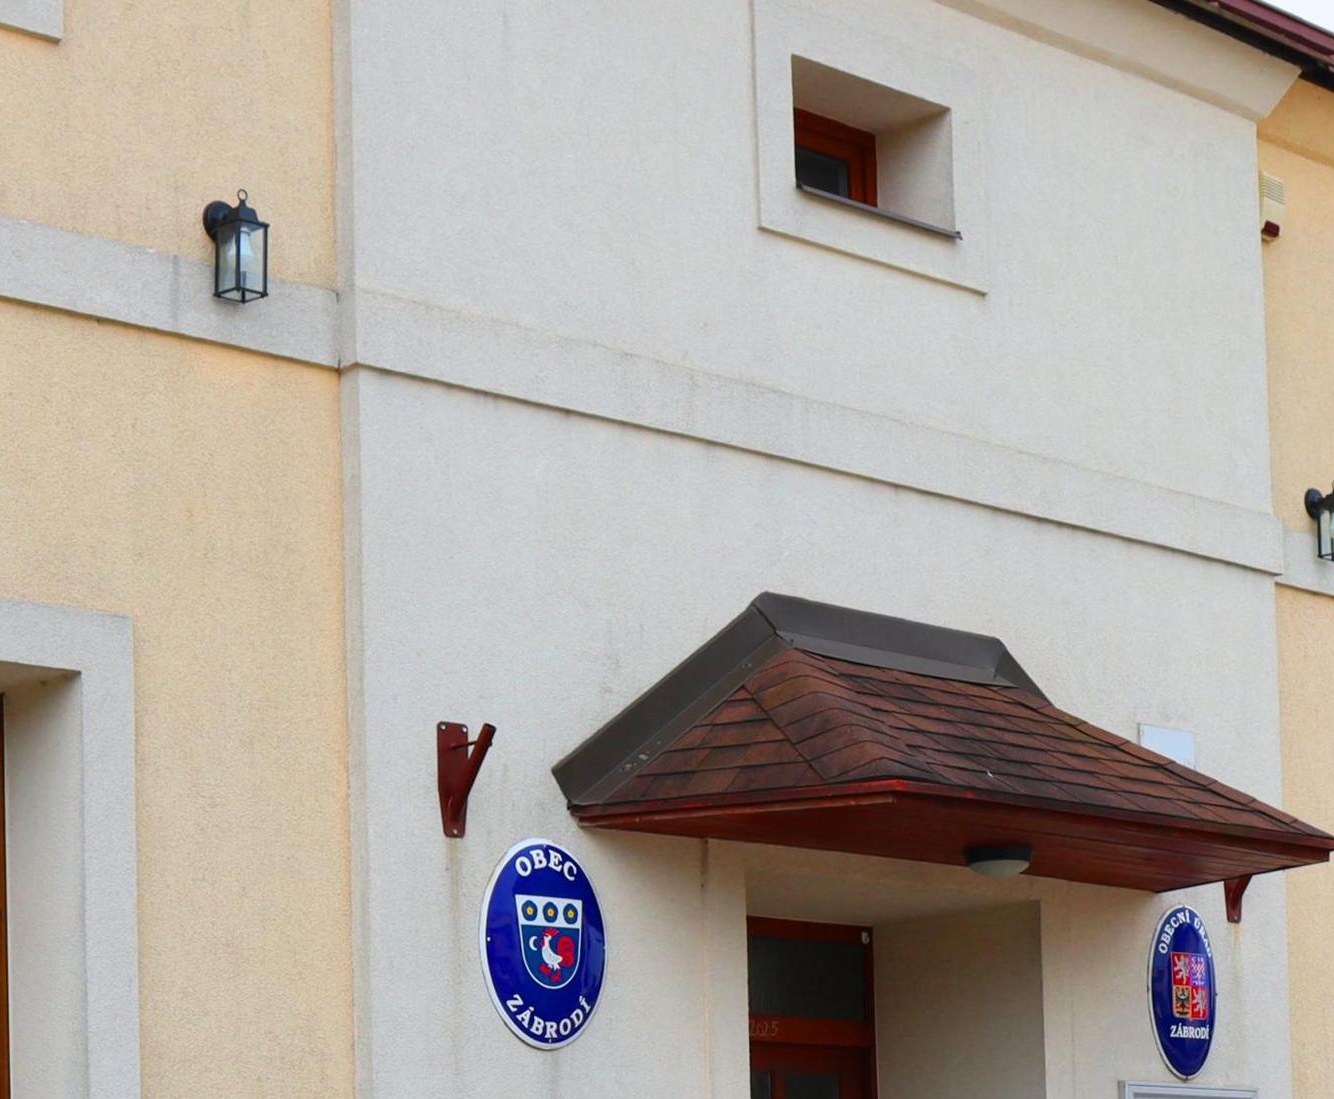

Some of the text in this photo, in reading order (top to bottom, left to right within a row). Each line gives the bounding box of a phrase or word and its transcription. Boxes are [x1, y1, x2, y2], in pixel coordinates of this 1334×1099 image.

[515, 849, 577, 881] OBEC
[1158, 909, 1190, 955] OBECNÍ
[506, 994, 592, 1039] ZÁBRODÍ
[1170, 1023, 1210, 1040] ZÁBRODÍ
